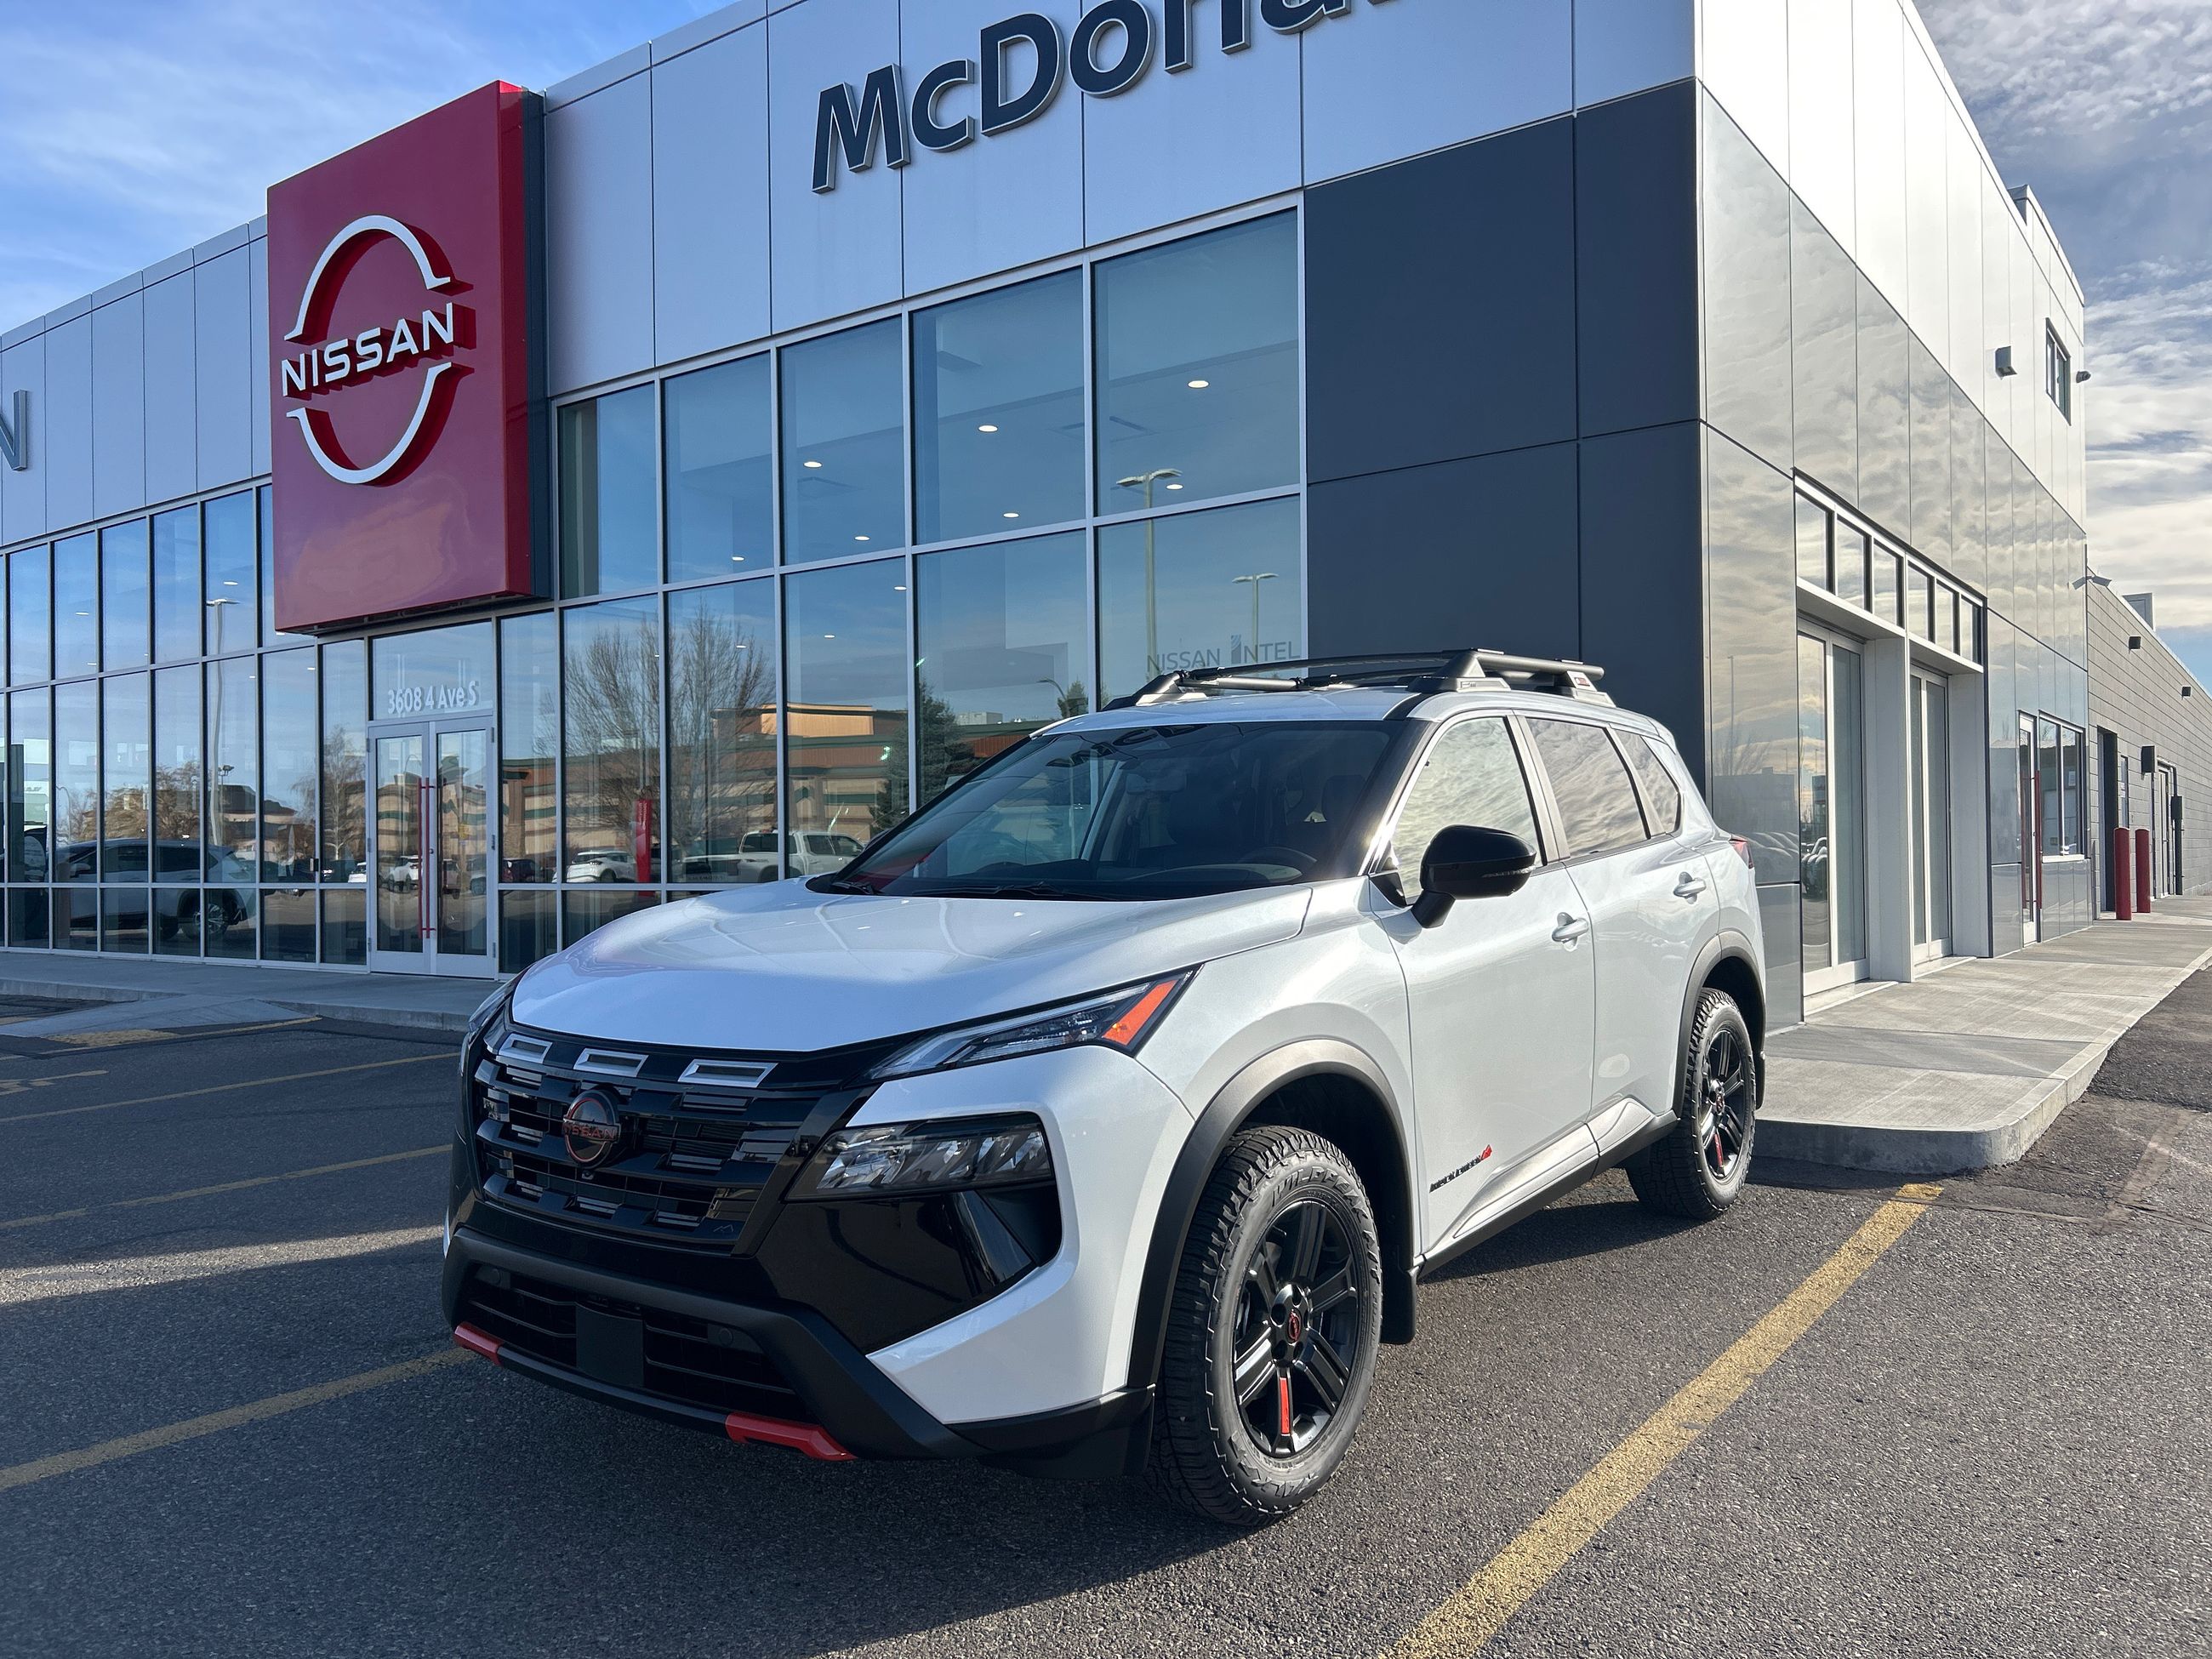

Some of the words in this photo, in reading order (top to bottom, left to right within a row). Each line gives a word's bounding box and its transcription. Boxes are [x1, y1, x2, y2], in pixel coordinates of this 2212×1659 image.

[811, 0, 1397, 194] McDon
[282, 302, 454, 396] NISSAN
[1148, 648, 1221, 672] NISSAN
[388, 687, 422, 715] 3608
[425, 685, 435, 710] 4
[438, 683, 465, 709] Ave
[469, 680, 478, 706] S
[563, 1122, 616, 1140] SSAN
